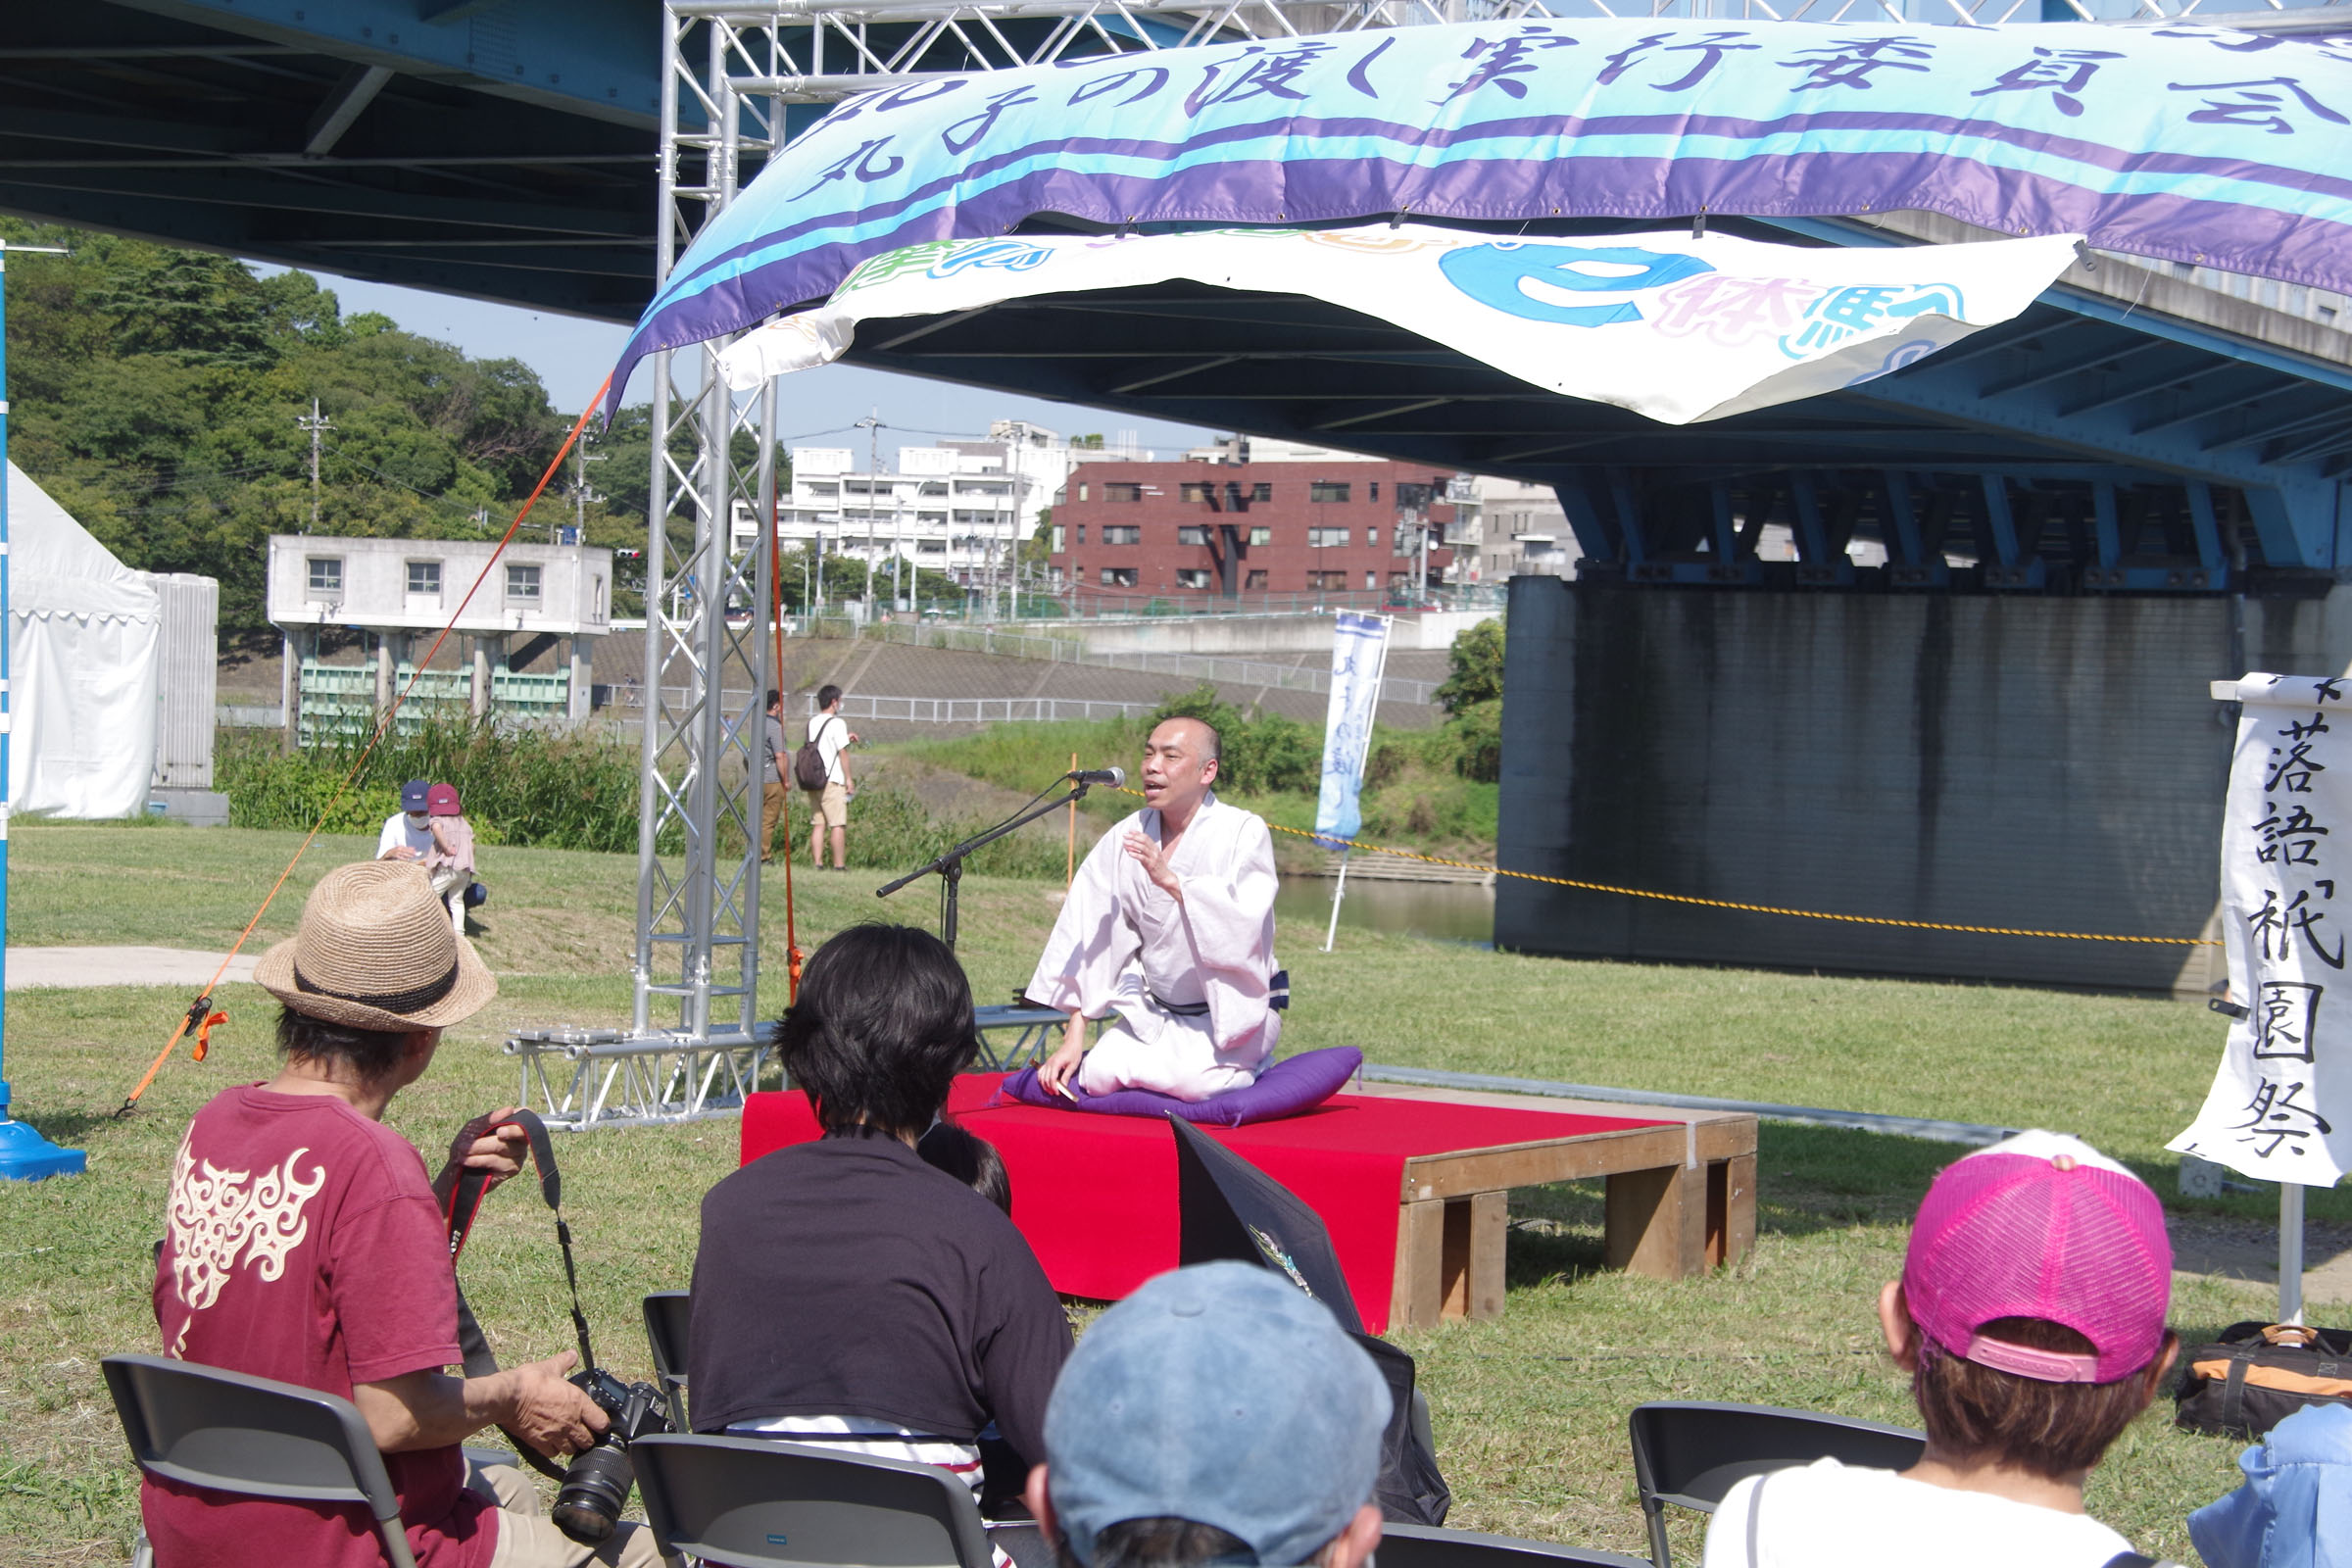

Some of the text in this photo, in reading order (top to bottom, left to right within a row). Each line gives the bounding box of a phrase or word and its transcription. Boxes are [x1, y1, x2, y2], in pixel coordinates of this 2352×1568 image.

[787, 26, 2351, 202] 丸子の渡し実行委員会
